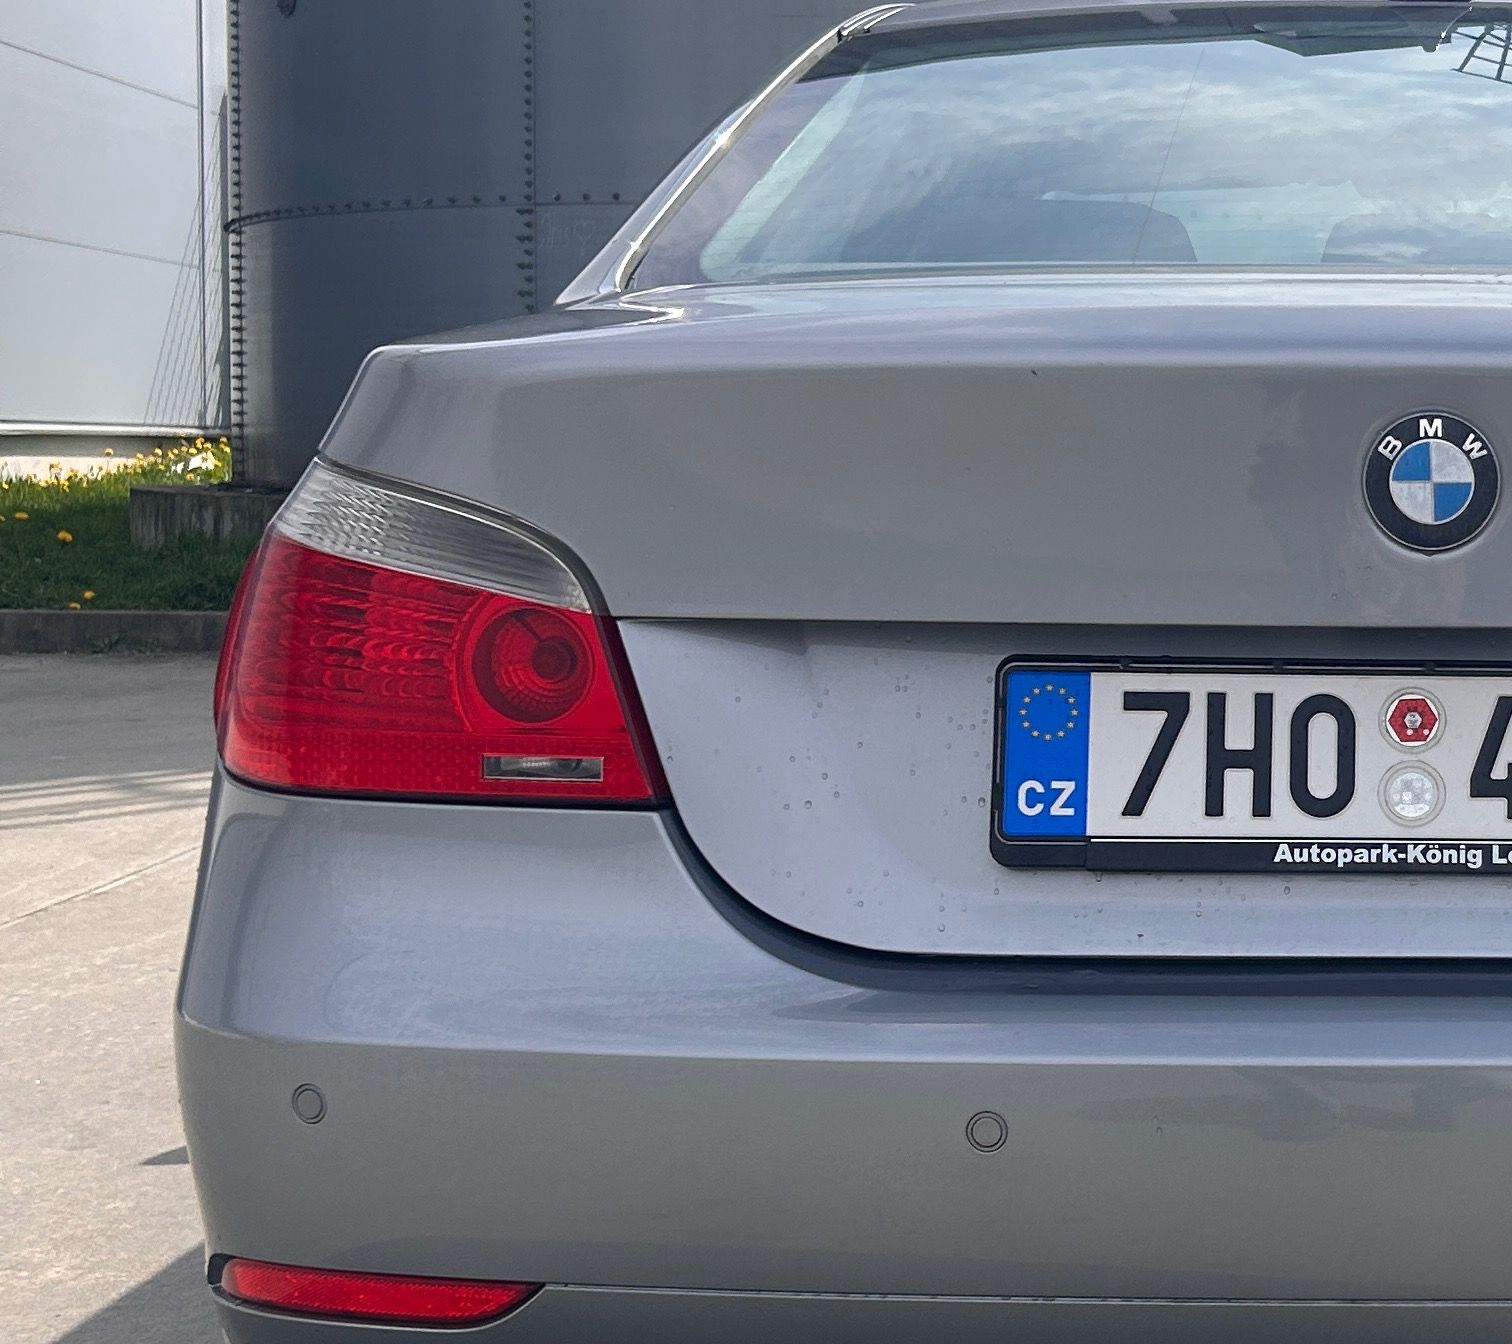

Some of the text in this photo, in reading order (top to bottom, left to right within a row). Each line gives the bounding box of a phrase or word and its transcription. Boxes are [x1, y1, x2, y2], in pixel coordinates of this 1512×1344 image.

[1377, 418, 1488, 460] BMW
[1120, 691, 1357, 818] 7H0
[1017, 779, 1076, 817] CZ
[1273, 843, 1483, 869] Autopark-König
